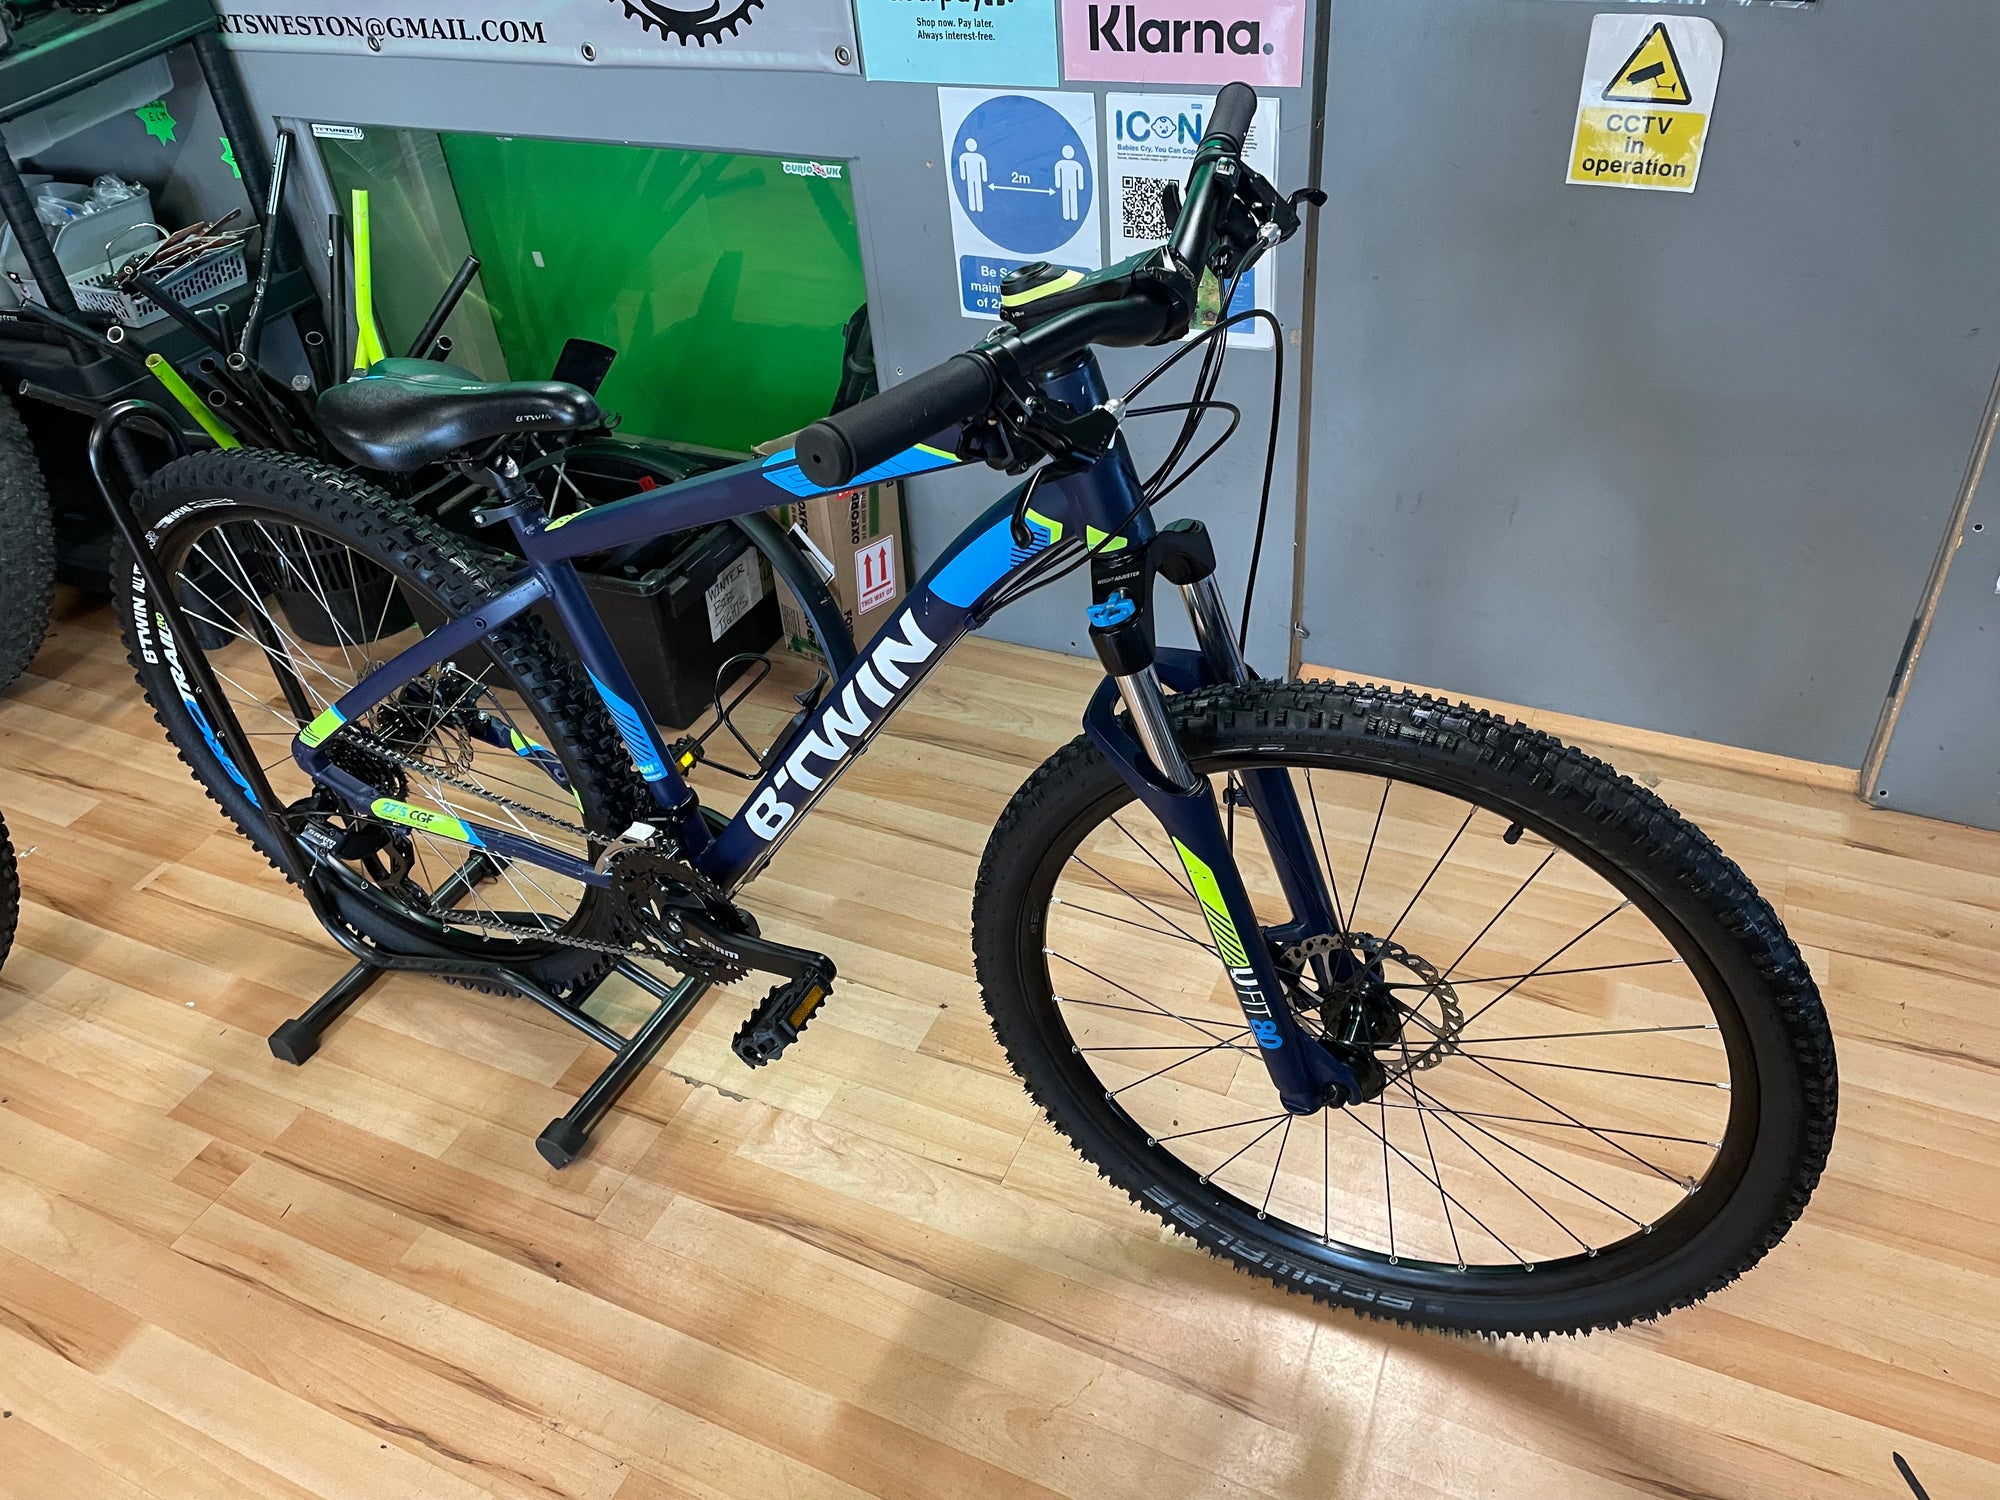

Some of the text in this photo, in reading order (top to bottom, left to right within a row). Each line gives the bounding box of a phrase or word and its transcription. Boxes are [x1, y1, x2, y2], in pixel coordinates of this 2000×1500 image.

[916, 17, 994, 29] Shop now. Pay later.
[1088, 4, 1275, 56] Klarna.
[917, 30, 996, 42] Always interest-free.
[1606, 114, 1673, 135] CCTV
[1117, 143, 1140, 152] Babies
[1168, 146, 1181, 155] Can
[1624, 136, 1645, 154] in
[1581, 157, 1687, 178] operation
[1010, 171, 1031, 185] 2m
[980, 265, 997, 278] Be
[976, 297, 989, 308] of
[850, 492, 861, 545] OXFORD
[131, 576, 146, 594] ALL
[707, 563, 745, 603] WINTER
[861, 586, 893, 608] THIS WAY UP
[714, 594, 749, 633] TIGHTS
[409, 810, 435, 824] CGF
[307, 828, 337, 847] SRAM
[699, 935, 740, 961] SRAM
[1250, 1018, 1284, 1051] 80
[1141, 1184, 1416, 1312] SCHWALBE
